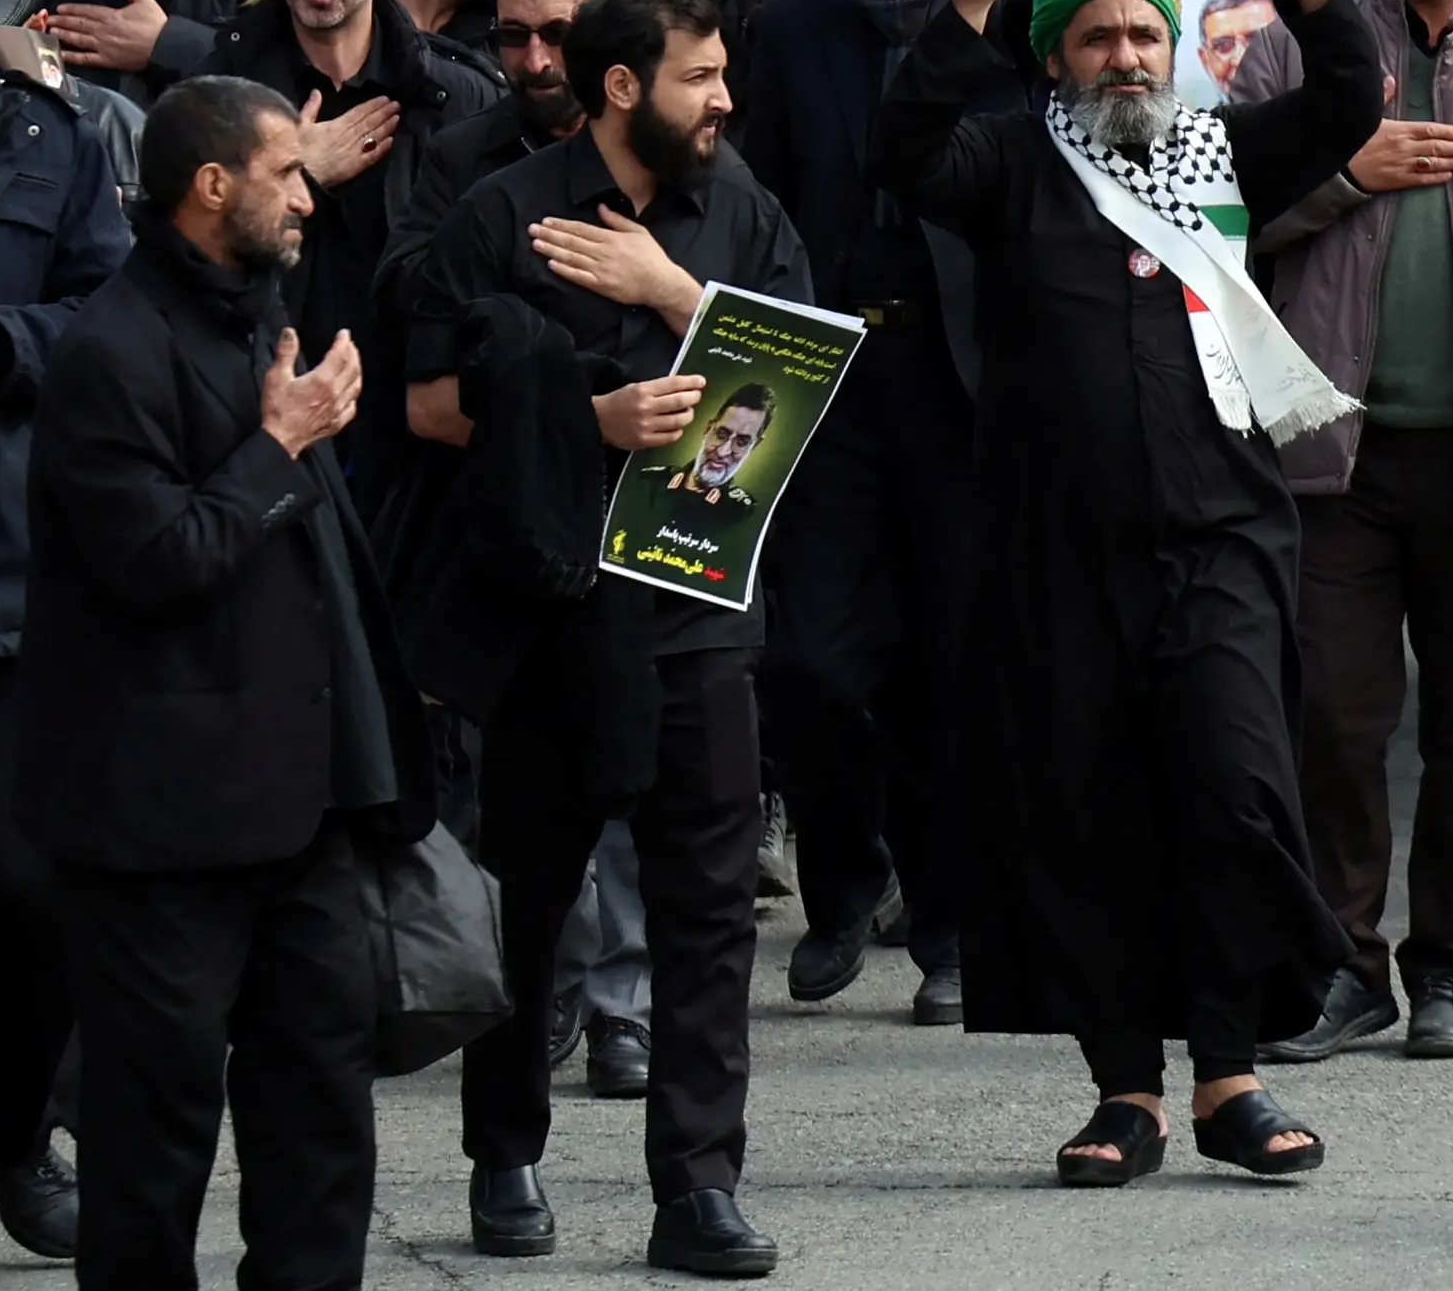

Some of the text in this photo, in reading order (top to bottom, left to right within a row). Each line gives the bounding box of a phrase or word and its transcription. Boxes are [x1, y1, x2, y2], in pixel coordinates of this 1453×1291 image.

[678, 532, 700, 548] سرتیپ
[697, 538, 720, 554] سردار
[702, 564, 727, 582] شهید
